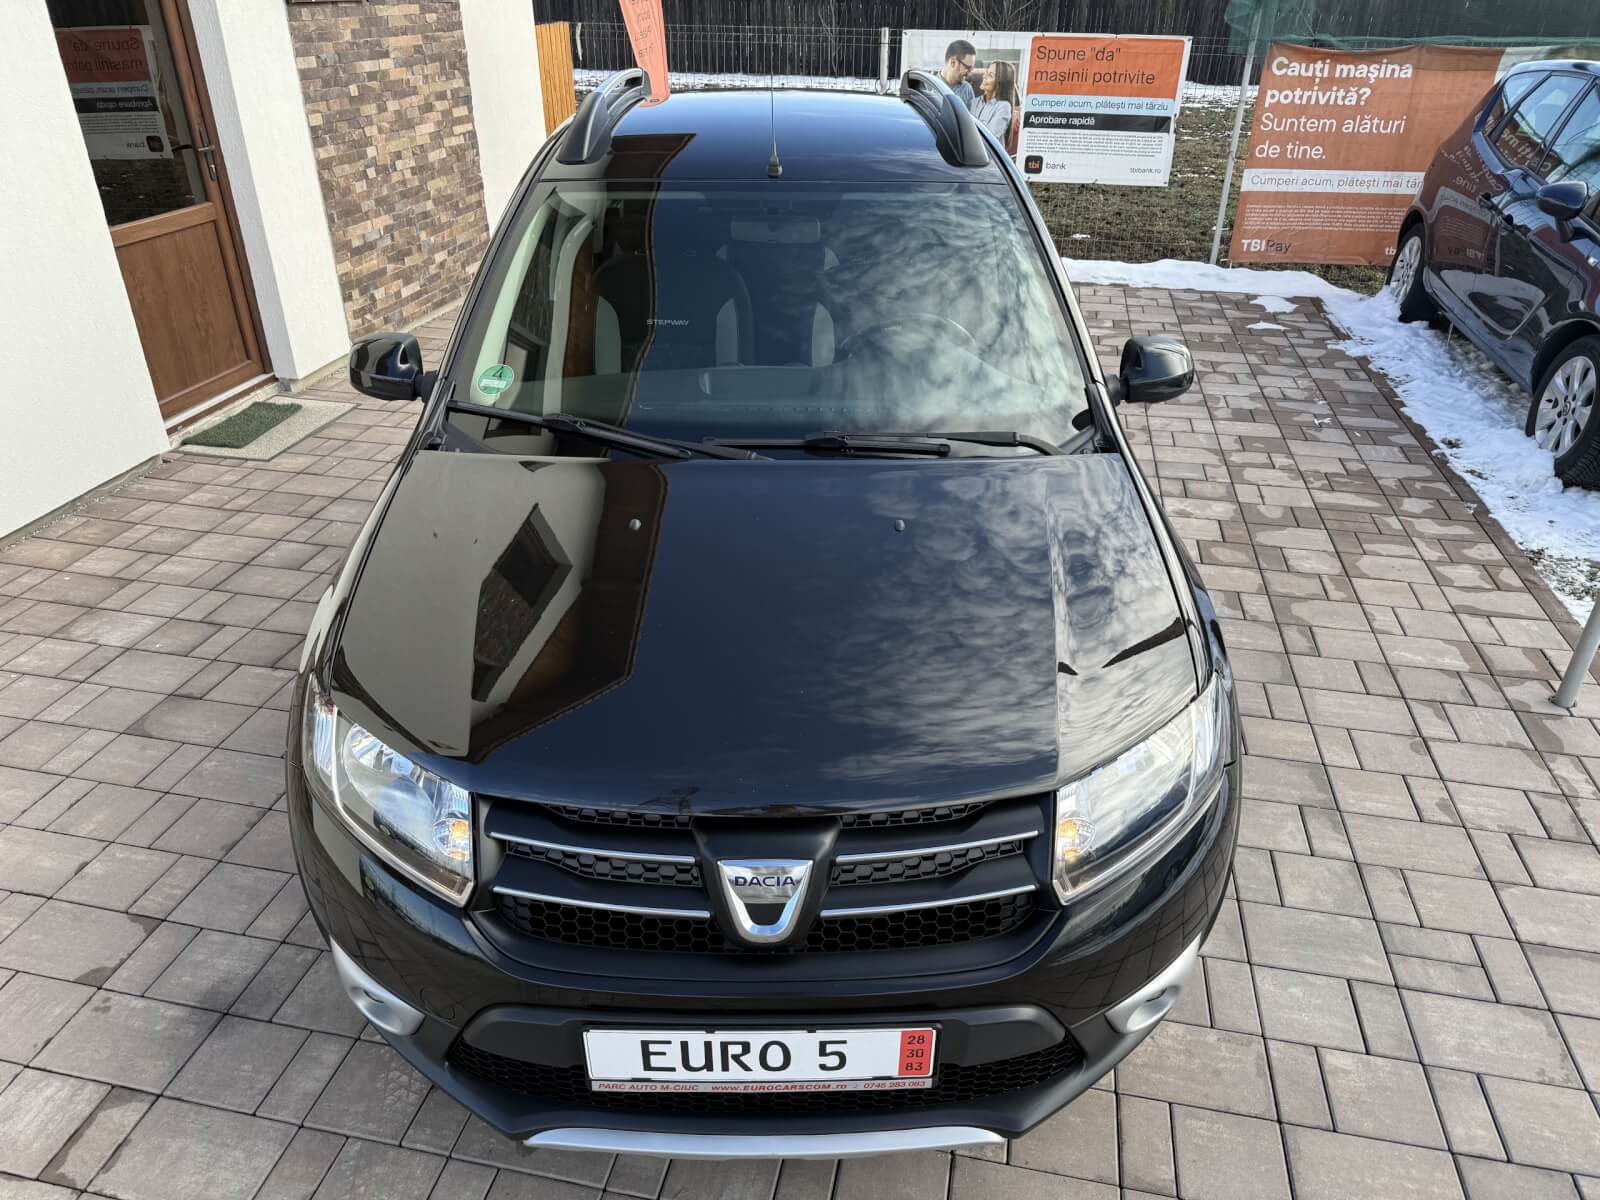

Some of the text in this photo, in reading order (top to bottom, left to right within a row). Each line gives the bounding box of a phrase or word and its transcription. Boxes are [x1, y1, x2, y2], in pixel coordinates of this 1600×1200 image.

[1036, 45, 1121, 63] Spune "da"
[1271, 56, 1331, 84] Cauți
[1034, 68, 1156, 86] mașinii potrivite
[1264, 86, 1372, 107] potrivită?
[1031, 97, 1067, 109] Cumperi
[1068, 100, 1093, 109] acum,
[1127, 100, 1144, 110] mai
[1029, 114, 1096, 127] Aprobare rapidă
[1260, 112, 1407, 134] Suntem alături
[1255, 140, 1327, 159] de tine.
[1045, 162, 1067, 171] bank
[1251, 174, 1298, 188] Cumperi
[1301, 178, 1334, 188] acum,
[1382, 177, 1403, 188] mai
[492, 365, 504, 378] 4
[734, 876, 796, 887] DACIA
[907, 1034, 926, 1045] 28
[640, 1039, 848, 1073] EURO 5
[906, 1048, 924, 1058] 30
[905, 1062, 923, 1071] 83
[629, 1083, 658, 1091] AUTO
[660, 1084, 699, 1092] M-CIUC
